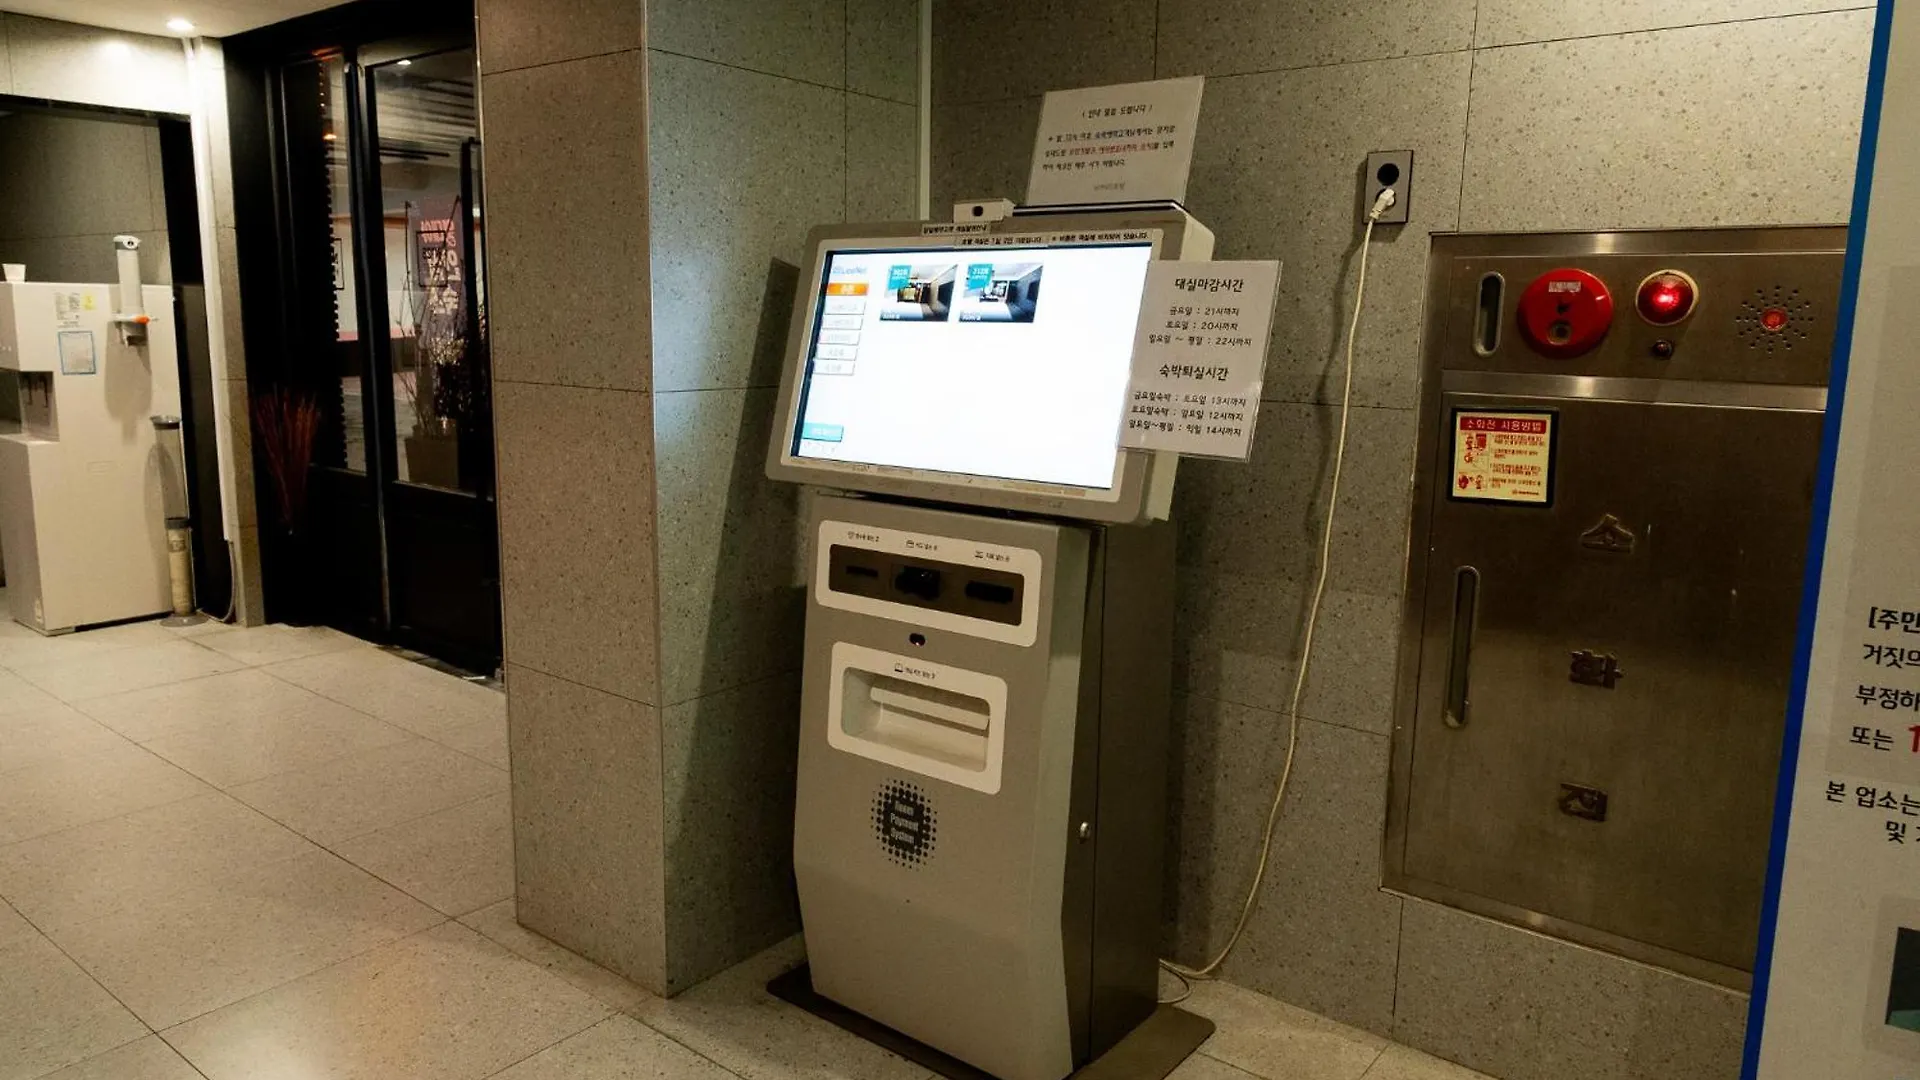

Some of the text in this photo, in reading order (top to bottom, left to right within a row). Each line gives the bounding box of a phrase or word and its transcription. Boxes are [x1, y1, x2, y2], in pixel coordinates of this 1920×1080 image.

[1120, 104, 1146, 116] 드립니다
[1175, 278, 1244, 293] 대실마감시간
[1169, 306, 1193, 316] 금요일
[1204, 307, 1240, 316] 21시까지
[1165, 321, 1189, 330] 토요일
[1201, 321, 1239, 331] 20시까지
[1149, 334, 1171, 344] 일요일
[1215, 337, 1252, 347] 22시까지
[1159, 364, 1229, 381] 숙박퇴실시간
[1134, 391, 1171, 402] 금요일숙박
[1184, 395, 1207, 405] 토요일
[1131, 405, 1169, 417] 토요일숙박
[1181, 409, 1204, 420] 일요일
[1209, 411, 1244, 422] 12시까지
[1206, 426, 1242, 437] 14시까지
[1466, 419, 1542, 432] 소화전 사용방법
[1856, 684, 1920, 712] 부정하
[1849, 726, 1894, 752] 또는
[1826, 781, 1920, 817] 본 업소는
[1886, 820, 1907, 844] 및
